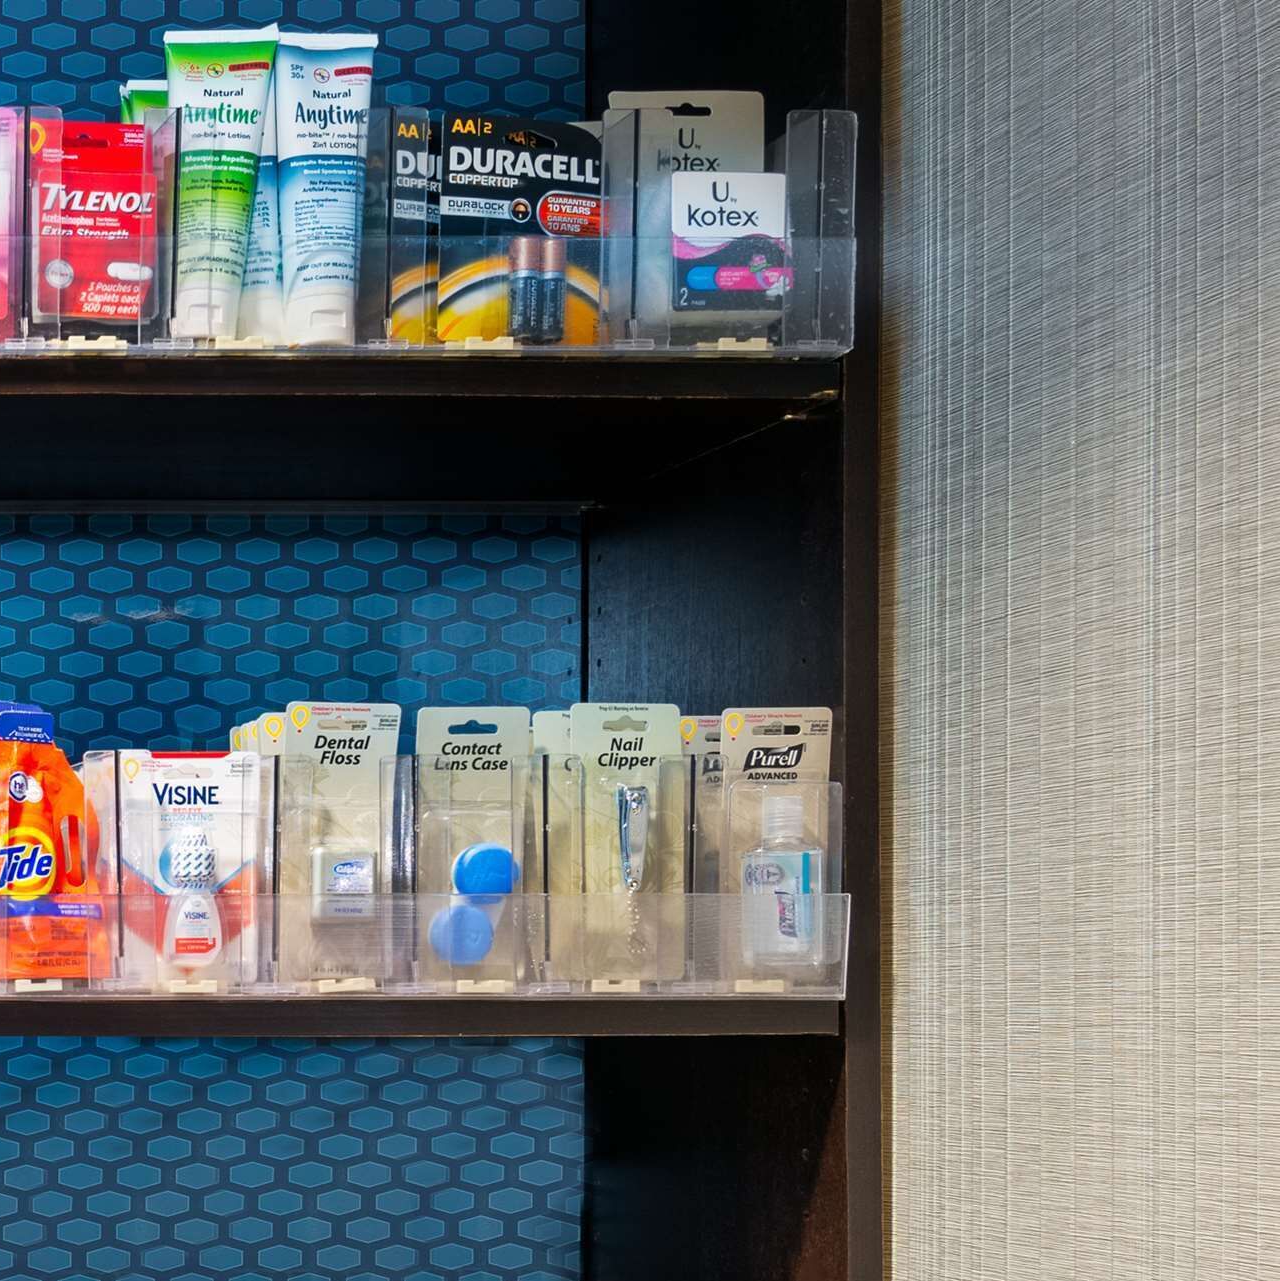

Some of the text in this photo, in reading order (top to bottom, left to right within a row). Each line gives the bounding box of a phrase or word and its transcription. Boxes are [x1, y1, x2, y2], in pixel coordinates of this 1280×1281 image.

[203, 88, 244, 98] Natural
[312, 89, 351, 99] Natural
[182, 102, 259, 128] Anytime
[295, 103, 368, 129] Anytime
[449, 146, 600, 184] DURACELL
[449, 173, 518, 188] COPPERTOP
[42, 182, 153, 213] TYLENOL
[712, 181, 730, 203] U
[687, 203, 758, 228] kotex
[314, 735, 370, 750] Dental
[441, 742, 502, 756] Contact
[610, 738, 643, 752] Nail
[320, 751, 361, 766] Floss
[434, 757, 508, 771] Lens Case
[598, 753, 657, 770] Clipper
[747, 772, 798, 781] ADVANCED
[153, 783, 220, 806] VISINE
